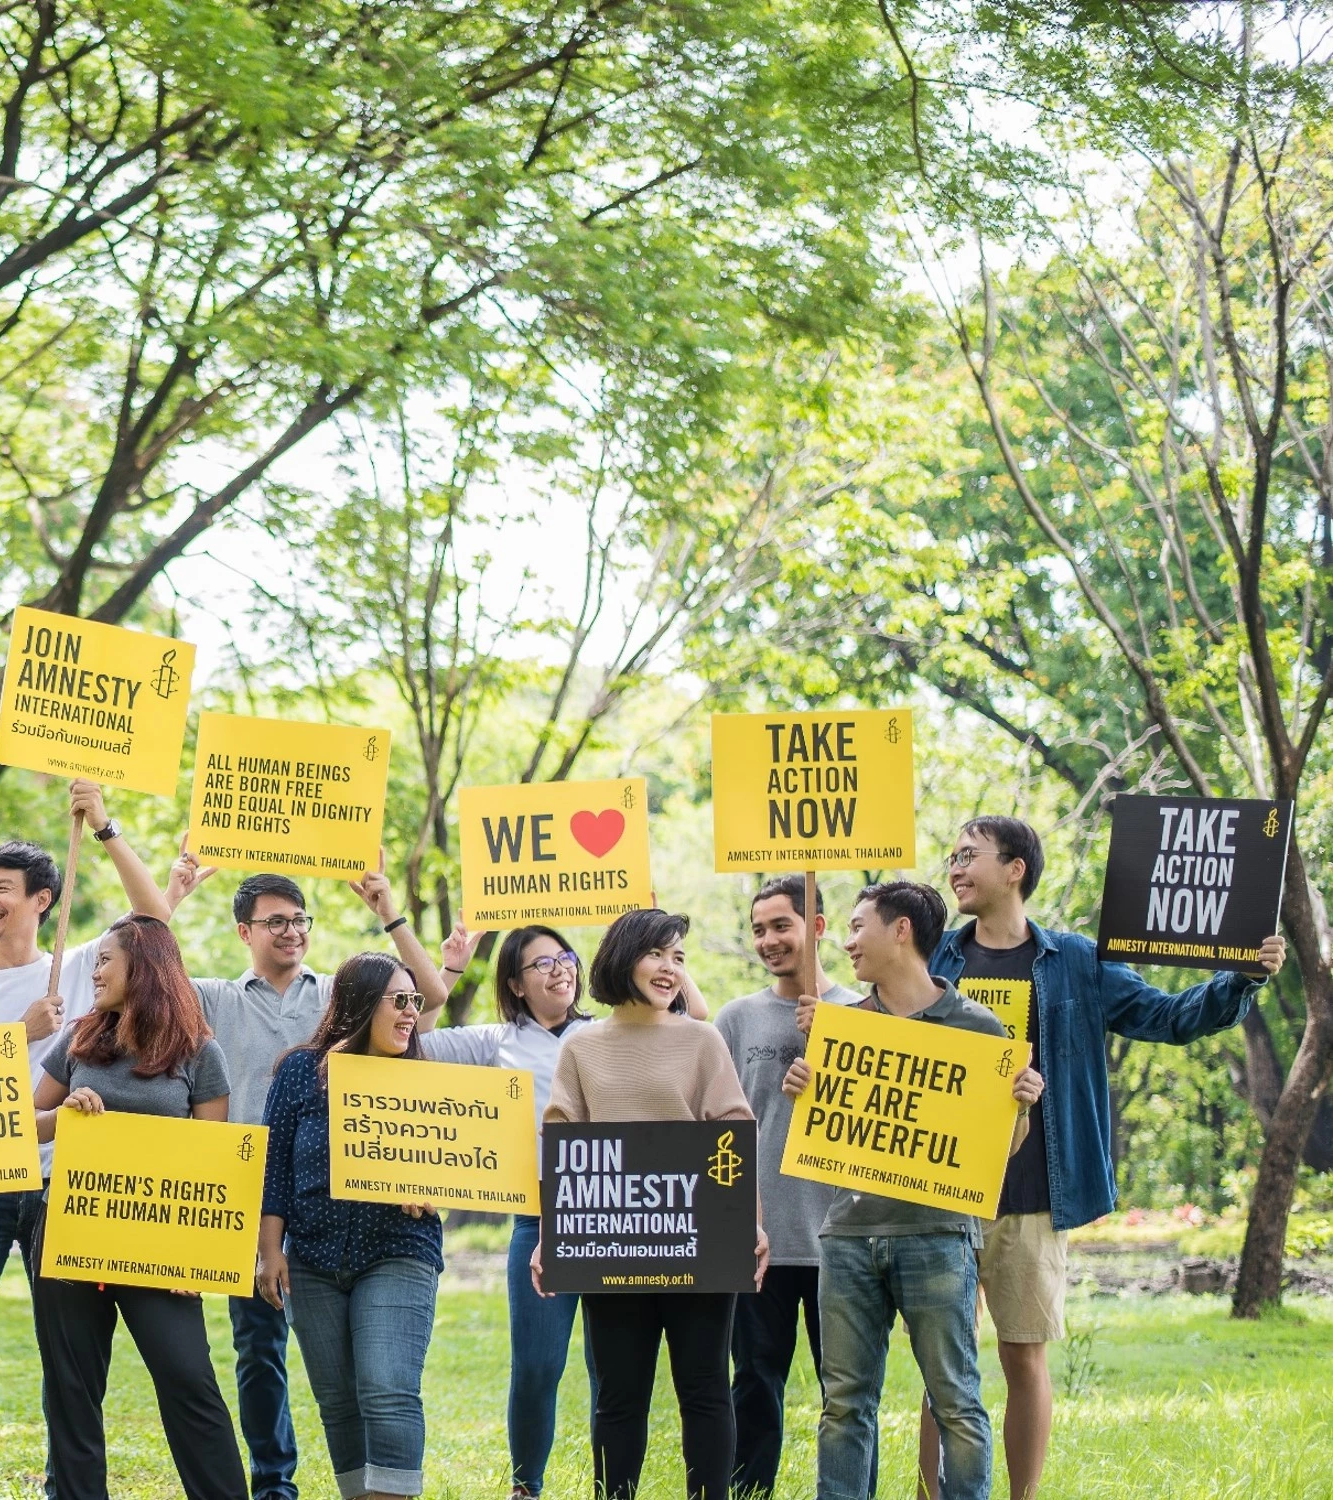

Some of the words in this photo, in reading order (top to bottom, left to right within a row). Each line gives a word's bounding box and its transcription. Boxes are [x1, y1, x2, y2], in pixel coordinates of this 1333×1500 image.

[21, 625, 81, 664] JOIN
[17, 658, 141, 709] AMNESTY
[14, 693, 134, 734] INTERNATIONAL
[11, 719, 132, 755] ร่วมมือกับแอมเนสตี้
[765, 722, 856, 763] TAKE
[207, 753, 232, 770] ALL
[237, 756, 290, 776] HUMAN
[295, 762, 350, 782] BEINGS
[767, 766, 857, 793] ACTION
[205, 772, 234, 790] ARE
[239, 775, 280, 794] BORN
[285, 780, 322, 799] FREE
[201, 810, 231, 828] AND
[236, 813, 290, 834] RIGHTS
[203, 791, 232, 809] AND
[238, 795, 285, 814] EQUAL
[291, 799, 306, 816] IN
[311, 801, 371, 822] DIGNITY
[768, 797, 856, 838] NOW
[481, 813, 556, 863] WE
[1159, 806, 1240, 853] TAKE
[198, 844, 242, 858] AMNESTY
[245, 849, 317, 866] INTERNATIONAL
[321, 856, 366, 871] THAILAND
[727, 850, 772, 861] AMNESTY
[775, 848, 851, 860] INTERNATIONAL
[854, 846, 902, 858] THAILAND
[1150, 853, 1234, 887] ACTION
[483, 873, 550, 895] HUMAN
[558, 869, 628, 891] RIGHTS
[475, 909, 517, 920] AMNESTY
[521, 906, 592, 918] INTERNATIONAL
[1146, 886, 1229, 935] NOW
[1107, 938, 1147, 952] AMNESTY
[1148, 941, 1215, 958] INTERNATIONAL
[967, 989, 1012, 1005] WRITE
[822, 1037, 966, 1096] TOGETHER
[343, 1092, 498, 1119] เรารวมพลังกัน
[814, 1071, 858, 1109] WE
[863, 1083, 922, 1123] ARE
[343, 1114, 456, 1141] สร้างความ
[804, 1106, 960, 1168] POWERFUL
[344, 1135, 498, 1170] เปลี่ยนแปลงได้
[554, 1139, 621, 1173] JOIN
[67, 1169, 153, 1196] WOMEN'S
[160, 1178, 226, 1204] RIGHTS
[344, 1178, 391, 1192] AMNESTY
[395, 1183, 473, 1199] INTERNATIONAL
[477, 1189, 525, 1203] THAILAND
[555, 1173, 698, 1208] AMNESTY
[796, 1153, 845, 1173] AMNESTY
[848, 1163, 928, 1192] INTERNATIONAL
[933, 1182, 984, 1203] THAILAND
[63, 1194, 100, 1216] ARE
[106, 1198, 170, 1223] HUMAN
[177, 1205, 244, 1230] RIGHTS
[556, 1212, 697, 1234] INTERNATIONAL
[556, 1236, 697, 1257] ร่วมมือกับแอมเนสตี้
[55, 1254, 103, 1270] AMNESTY
[107, 1259, 186, 1278] INTERNATIONAL
[190, 1267, 240, 1283] THAILAND
[602, 1273, 693, 1287] www.amnesty.or.th
